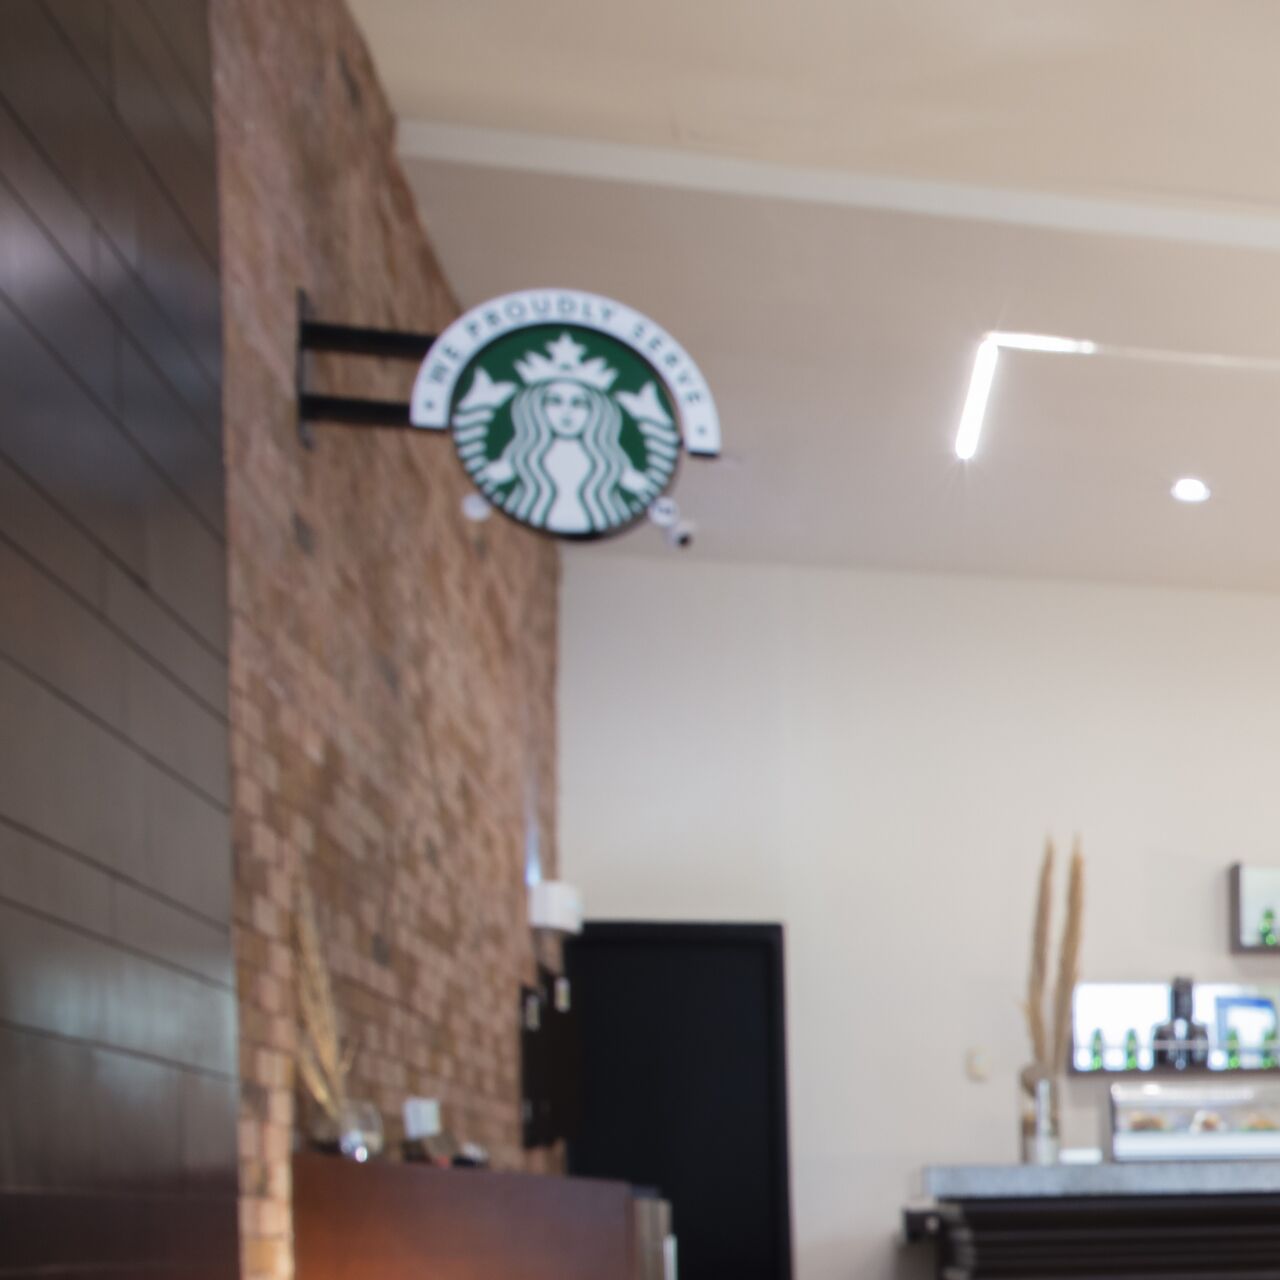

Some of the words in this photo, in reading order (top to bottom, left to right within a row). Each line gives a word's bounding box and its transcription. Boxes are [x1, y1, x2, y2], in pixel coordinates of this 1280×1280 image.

[432, 344, 461, 384] WE
[465, 296, 616, 336] PROUDLY
[632, 323, 702, 404] SERVE
